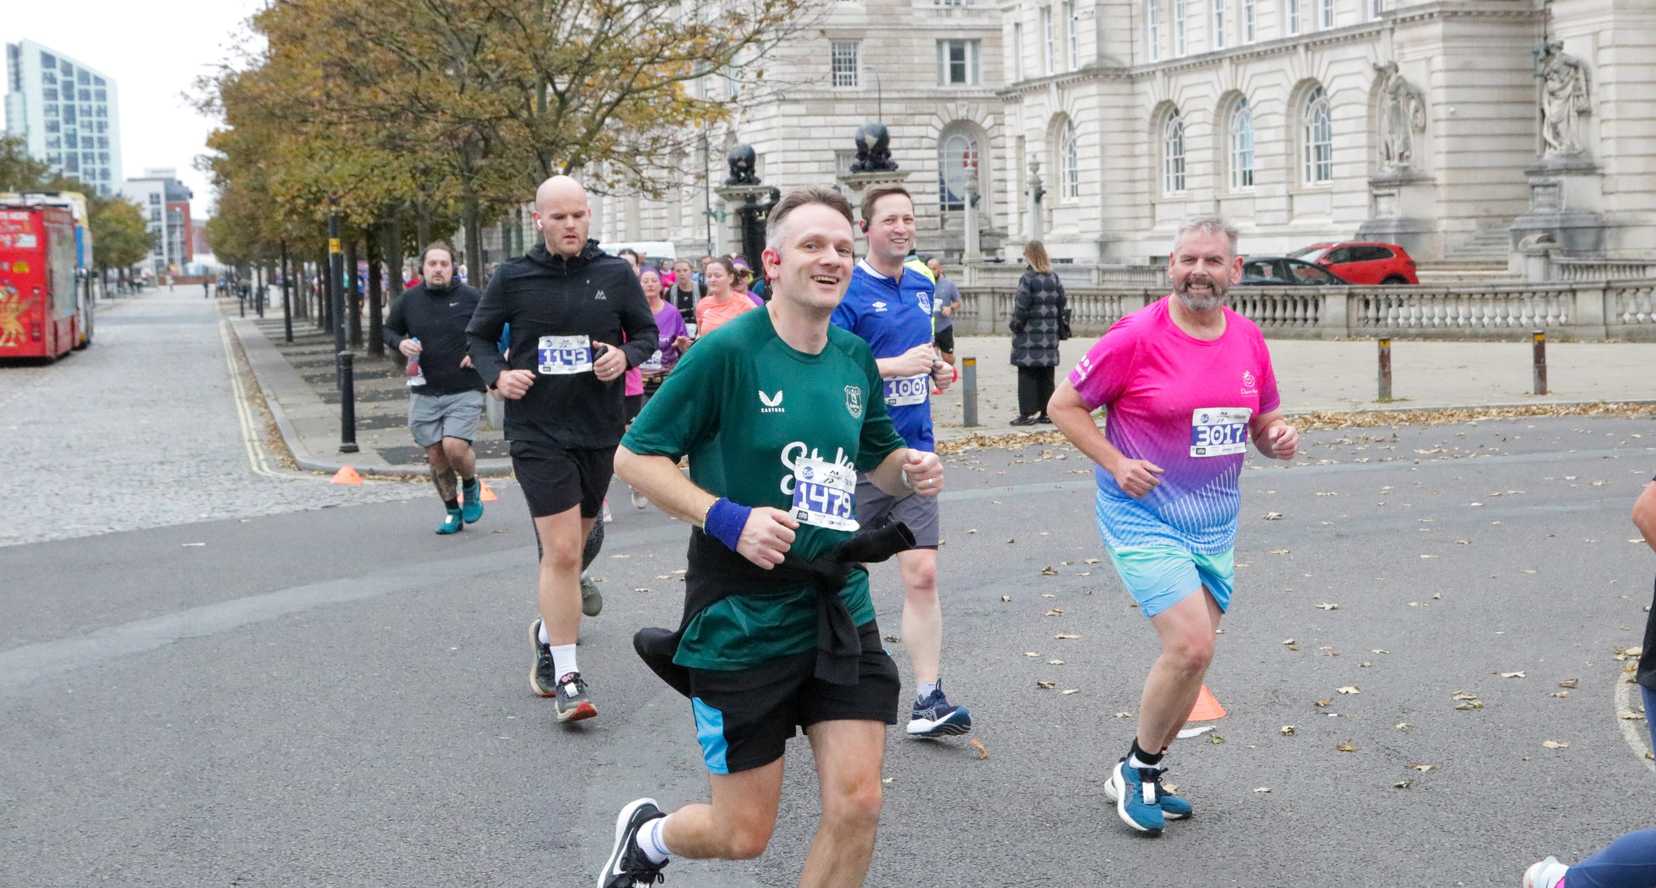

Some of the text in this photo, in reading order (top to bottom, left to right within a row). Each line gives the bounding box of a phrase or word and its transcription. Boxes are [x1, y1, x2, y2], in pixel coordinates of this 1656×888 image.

[543, 349, 588, 368] 1143
[1196, 423, 1245, 446] 3017
[798, 482, 852, 519] 1479
